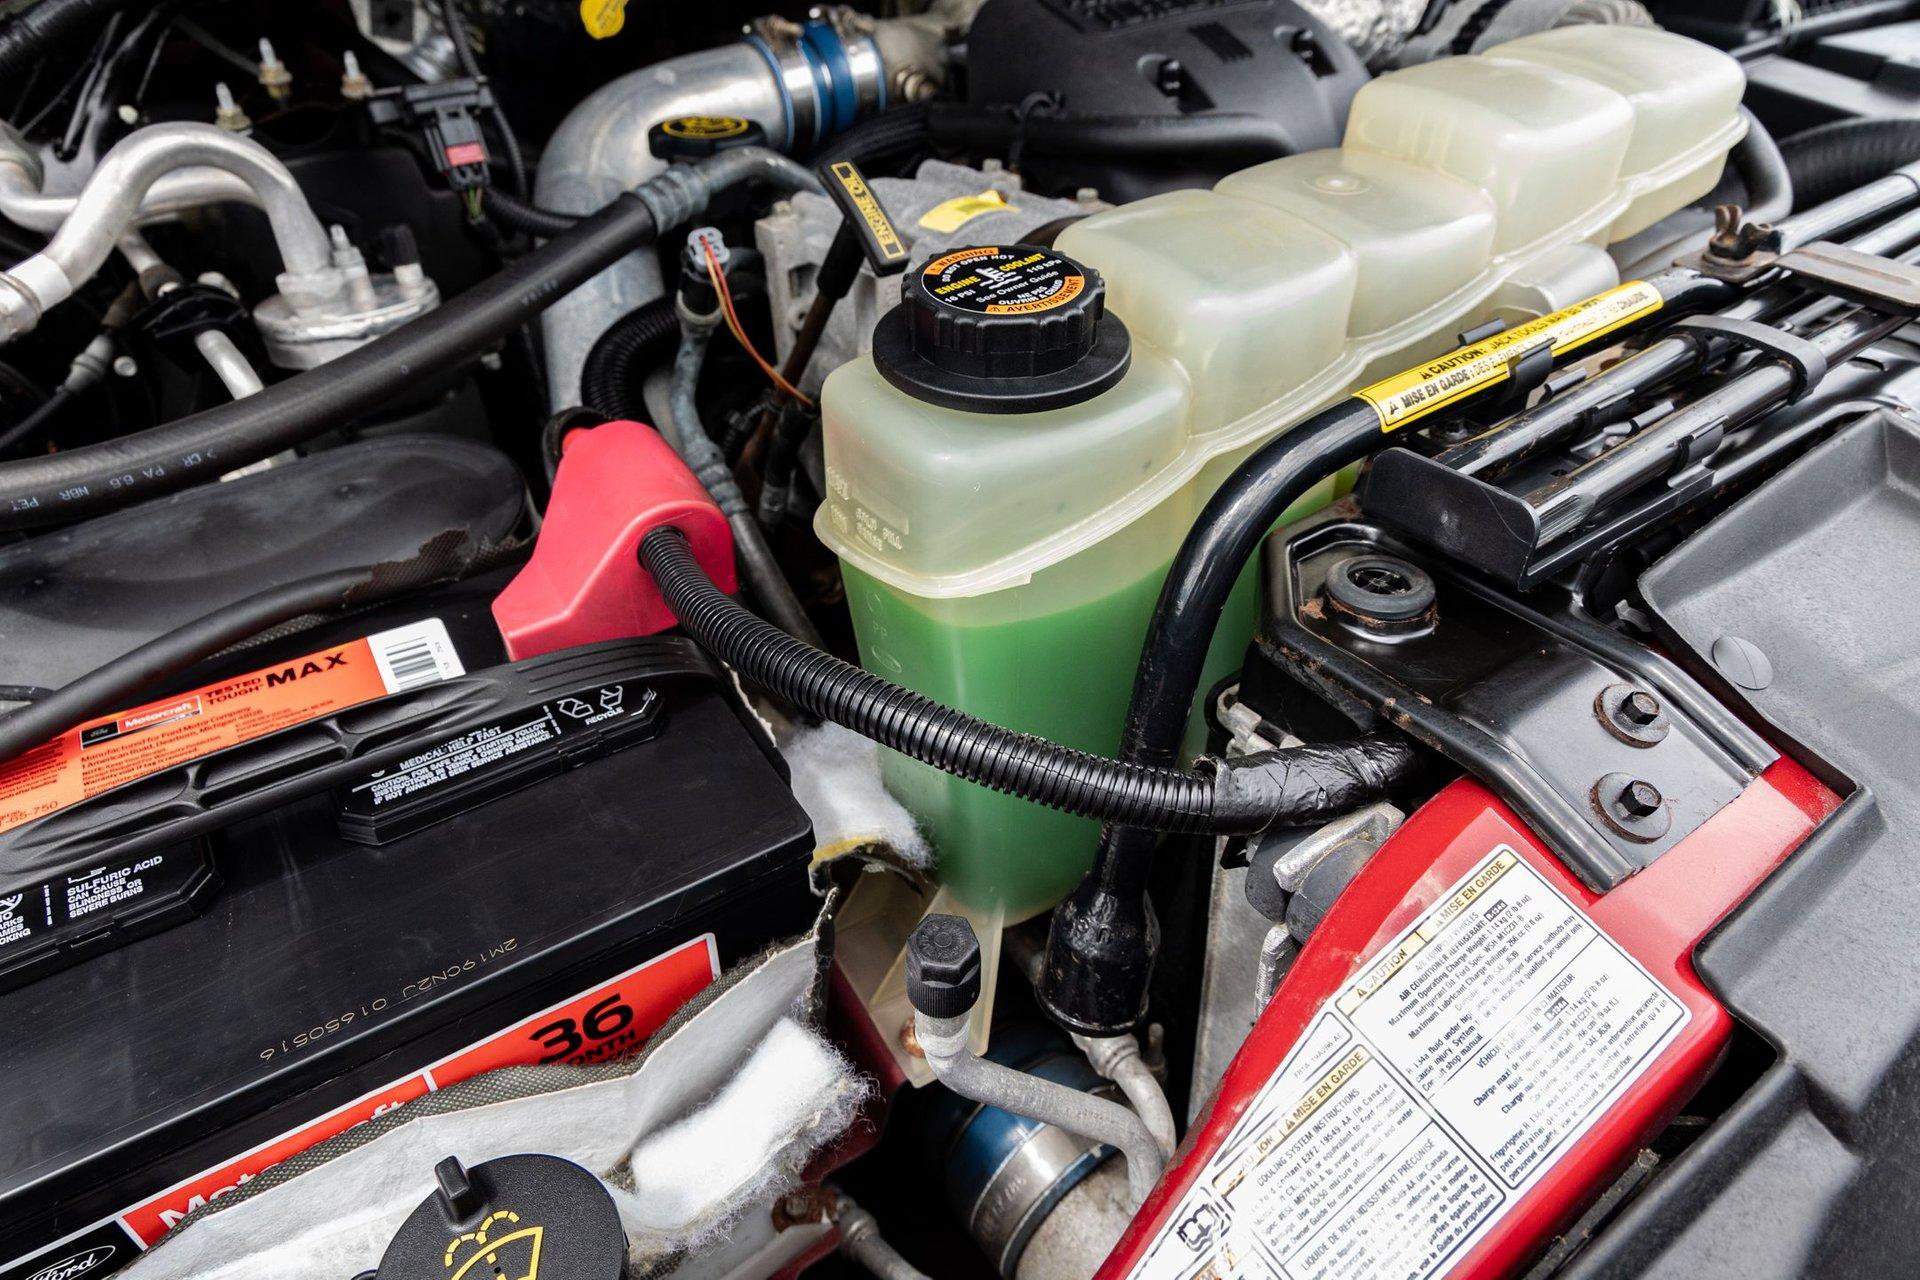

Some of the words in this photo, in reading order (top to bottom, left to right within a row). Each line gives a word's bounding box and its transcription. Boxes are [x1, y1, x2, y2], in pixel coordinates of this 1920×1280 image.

[934, 275, 981, 295] ENGINE
[999, 253, 1046, 271] COOLANT
[959, 289, 976, 298] PSI
[1045, 259, 1062, 268] kPa
[961, 256, 988, 266] OPEN
[976, 292, 996, 303] See
[999, 280, 1029, 296] Owner
[1030, 271, 1059, 283] Guide
[1006, 278, 1080, 312] AVERTISSEMENT
[1031, 285, 1048, 295] PAS
[1428, 349, 1485, 373] CAUTION:
[1401, 389, 1425, 407] MISE
[1424, 383, 1439, 396] EN
[1472, 360, 1490, 374] DES
[141, 467, 165, 479] PA
[59, 485, 90, 501] NBR
[205, 678, 260, 697] TESTED
[266, 652, 346, 686] MAX
[125, 702, 193, 728] Motorcraft
[209, 706, 251, 722] Company
[585, 706, 624, 726] RECYCLE
[399, 746, 444, 769] MEDICAL
[447, 734, 473, 752] HELP
[476, 726, 500, 741] FAST
[410, 767, 429, 778] FOR
[429, 758, 451, 770] SAFE
[451, 749, 473, 762] JUMP
[475, 734, 514, 752] STARTING
[514, 722, 545, 738] FOLLOW
[373, 796, 382, 804] IF
[384, 789, 402, 800] NOT
[405, 772, 447, 793] AVAILABLE
[448, 764, 469, 776] SEEK
[471, 750, 503, 767] SERVICE
[505, 732, 553, 754] ASSISTANCE.
[374, 771, 433, 796] INSTRUCTIONS
[435, 767, 445, 775] IN
[446, 754, 478, 770] VEHICLE
[480, 740, 513, 757] OWNERS
[66, 867, 131, 896] SULFURIC
[134, 855, 163, 873] ACID
[68, 891, 89, 903] CAN
[93, 878, 126, 894] CAUSE
[68, 885, 123, 911] BLINDNESS
[127, 878, 142, 889] OR
[69, 900, 109, 919] SEVERE
[110, 885, 144, 907] BURNS
[1364, 948, 1407, 987] CAUTION
[1440, 896, 1464, 919] MISE
[1461, 885, 1476, 899] EN
[1475, 860, 1505, 887] GARDE
[1388, 998, 1419, 1025] Maximum
[1417, 971, 1448, 998] Operating
[1445, 953, 1467, 972] Charge
[1399, 988, 1411, 1001] AIR
[1409, 954, 1448, 990] CONDITIONER
[1413, 986, 1447, 1017] Refrigerant
[1454, 965, 1470, 979] Ford
[1427, 1038, 1443, 1053] fluid
[1443, 1023, 1460, 1040] under
[1524, 944, 1543, 963] service
[1543, 924, 1564, 945] methods
[1563, 914, 1575, 925] may
[1408, 1011, 1439, 1038] Maximum
[1437, 983, 1466, 1011] Lubricant
[1464, 966, 1487, 985] Charge
[1417, 1064, 1433, 1082] cause
[1451, 1025, 1475, 1046] System
[1524, 955, 1547, 979] qualified
[1546, 932, 1571, 958] personnel
[1607, 1015, 1636, 1044] intervention
[1635, 991, 1658, 1016] incorrecte
[259, 998, 388, 1061] 01650516
[528, 992, 634, 1065] 36
[566, 1028, 636, 1065] ONTH
[1445, 1054, 1461, 1070] shop
[1292, 1096, 1317, 1119] MISE
[1316, 1082, 1331, 1097] EN
[1330, 1052, 1362, 1083] GARDE
[1473, 1085, 1496, 1106] Charge
[1501, 1092, 1523, 1113] Charge
[1257, 1156, 1286, 1186] COOLING
[1285, 1131, 1313, 1158] SYSTEM
[1312, 1088, 1359, 1133] INSTRUCTIONS
[1315, 1160, 1321, 1168] or
[1322, 1130, 1353, 1161] equivalent
[1352, 1124, 1360, 1132] to
[1359, 1109, 1374, 1123] Ford
[1296, 1208, 1309, 1220] Use
[1328, 1167, 1352, 1190] mixture
[1352, 1158, 1359, 1167] of
[1397, 1108, 1412, 1125] water
[1334, 1150, 1350, 1168] avoid
[1424, 1149, 1448, 1170] Canada
[1441, 1155, 1460, 1173] norme
[1448, 1164, 1468, 1185] moteur
[1499, 1154, 1515, 1172] peut
[1508, 1149, 1537, 1181] personnel
[1290, 1224, 1309, 1242] Owner
[1309, 1208, 1328, 1225] Guide
[1326, 1198, 1336, 1209] for
[1337, 1183, 1353, 1199] more
[1301, 1242, 1328, 1270] LIQUIDE
[1327, 1232, 1339, 1244] DE
[1397, 1138, 1434, 1175] PRÉCONISÉ
[1438, 1203, 1447, 1213] de
[1446, 1182, 1469, 1203] liquide
[1469, 1173, 1478, 1183] de
[1429, 1221, 1449, 1245] parties
[1470, 1182, 1486, 1198] Pour
[1419, 1257, 1430, 1270] voir
[1436, 1234, 1454, 1252] Guide
[1453, 1226, 1463, 1236] du
